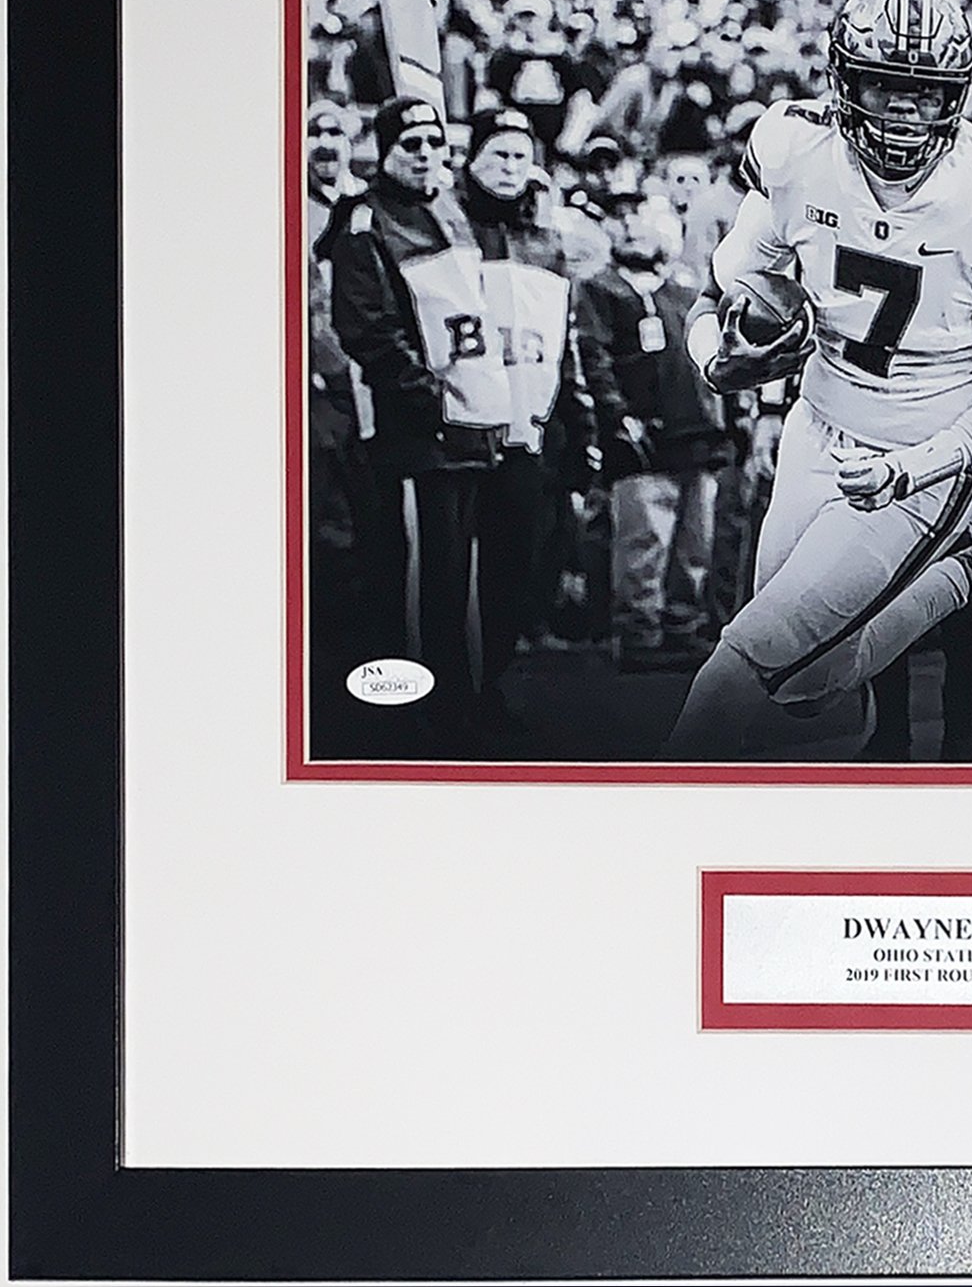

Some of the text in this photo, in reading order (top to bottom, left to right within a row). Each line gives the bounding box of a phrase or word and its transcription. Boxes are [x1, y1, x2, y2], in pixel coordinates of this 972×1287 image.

[833, 244, 924, 379] 7
[843, 917, 972, 940] DWAYNE
[873, 948, 919, 963] OHIO
[846, 968, 879, 982] 2019
[884, 969, 932, 983] FIRST
